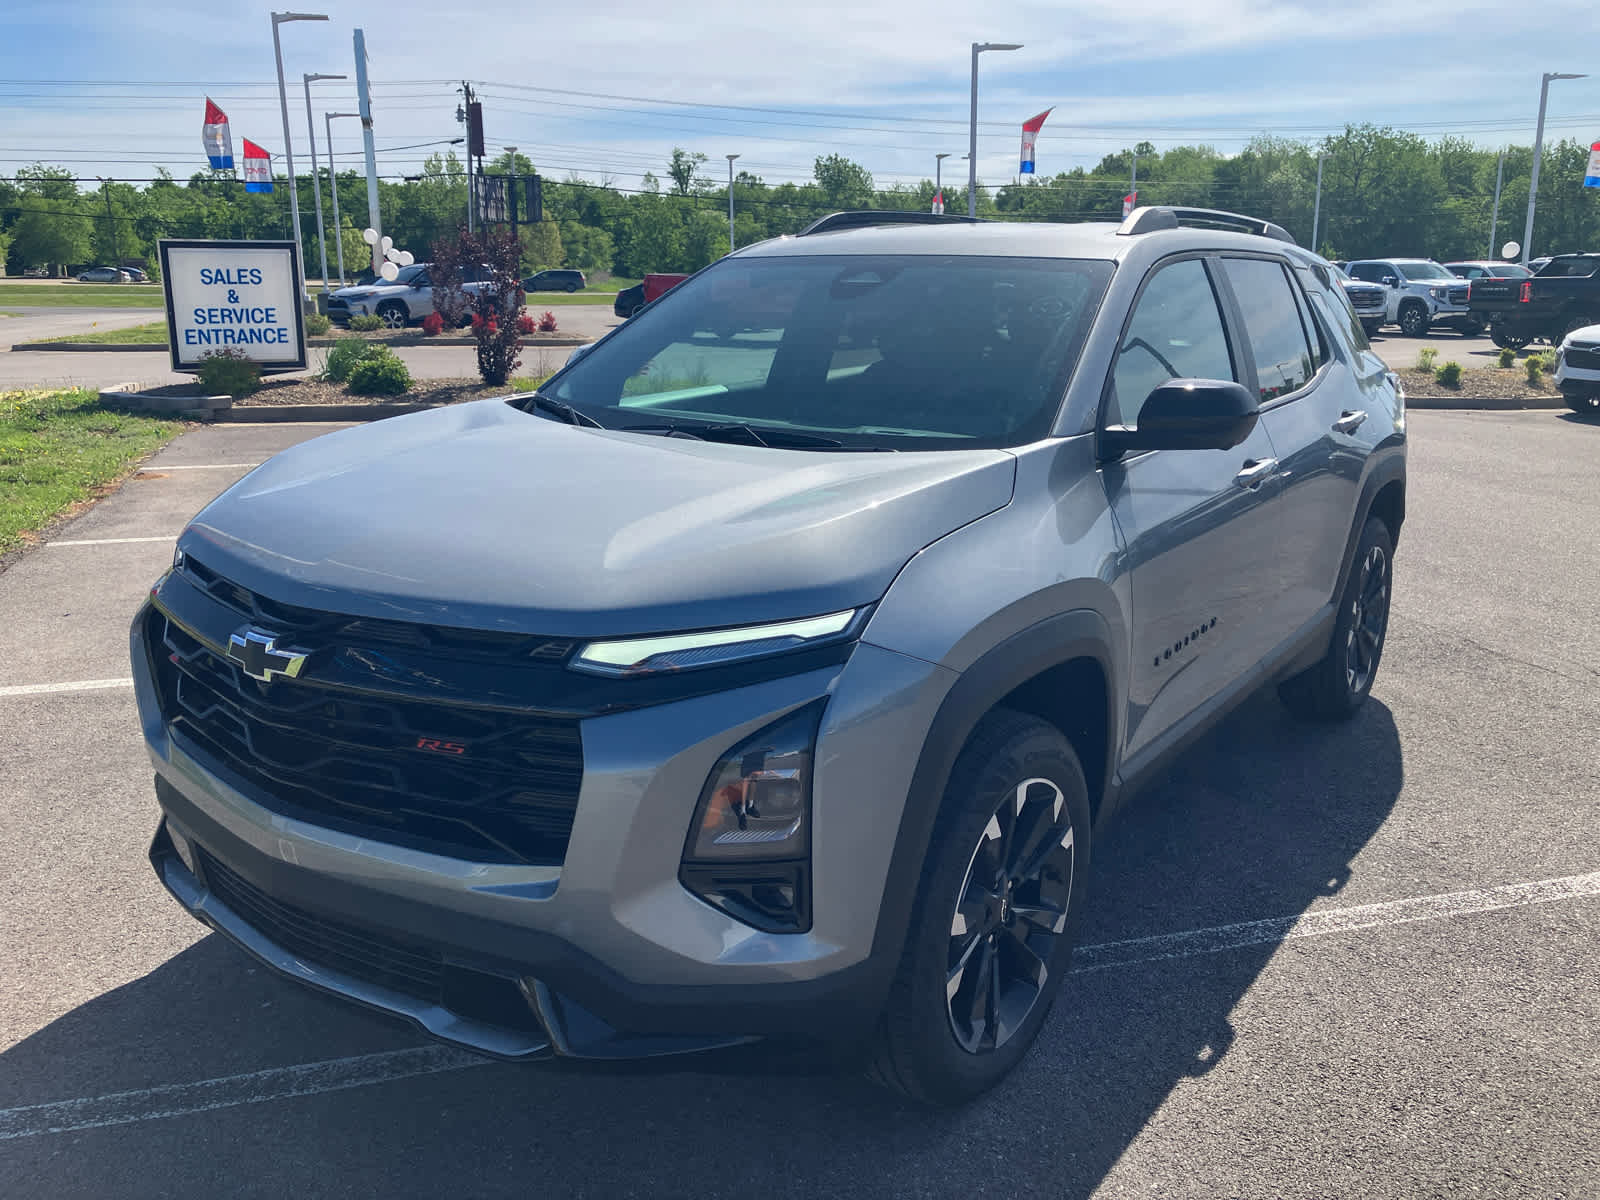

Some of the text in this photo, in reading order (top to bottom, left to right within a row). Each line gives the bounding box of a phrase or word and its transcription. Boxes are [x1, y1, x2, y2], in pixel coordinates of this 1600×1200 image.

[199, 268, 263, 285] SALES
[227, 289, 240, 304] &
[193, 308, 277, 325] SERVICE
[184, 328, 289, 345] ENTRANCE
[416, 737, 465, 754] RS
